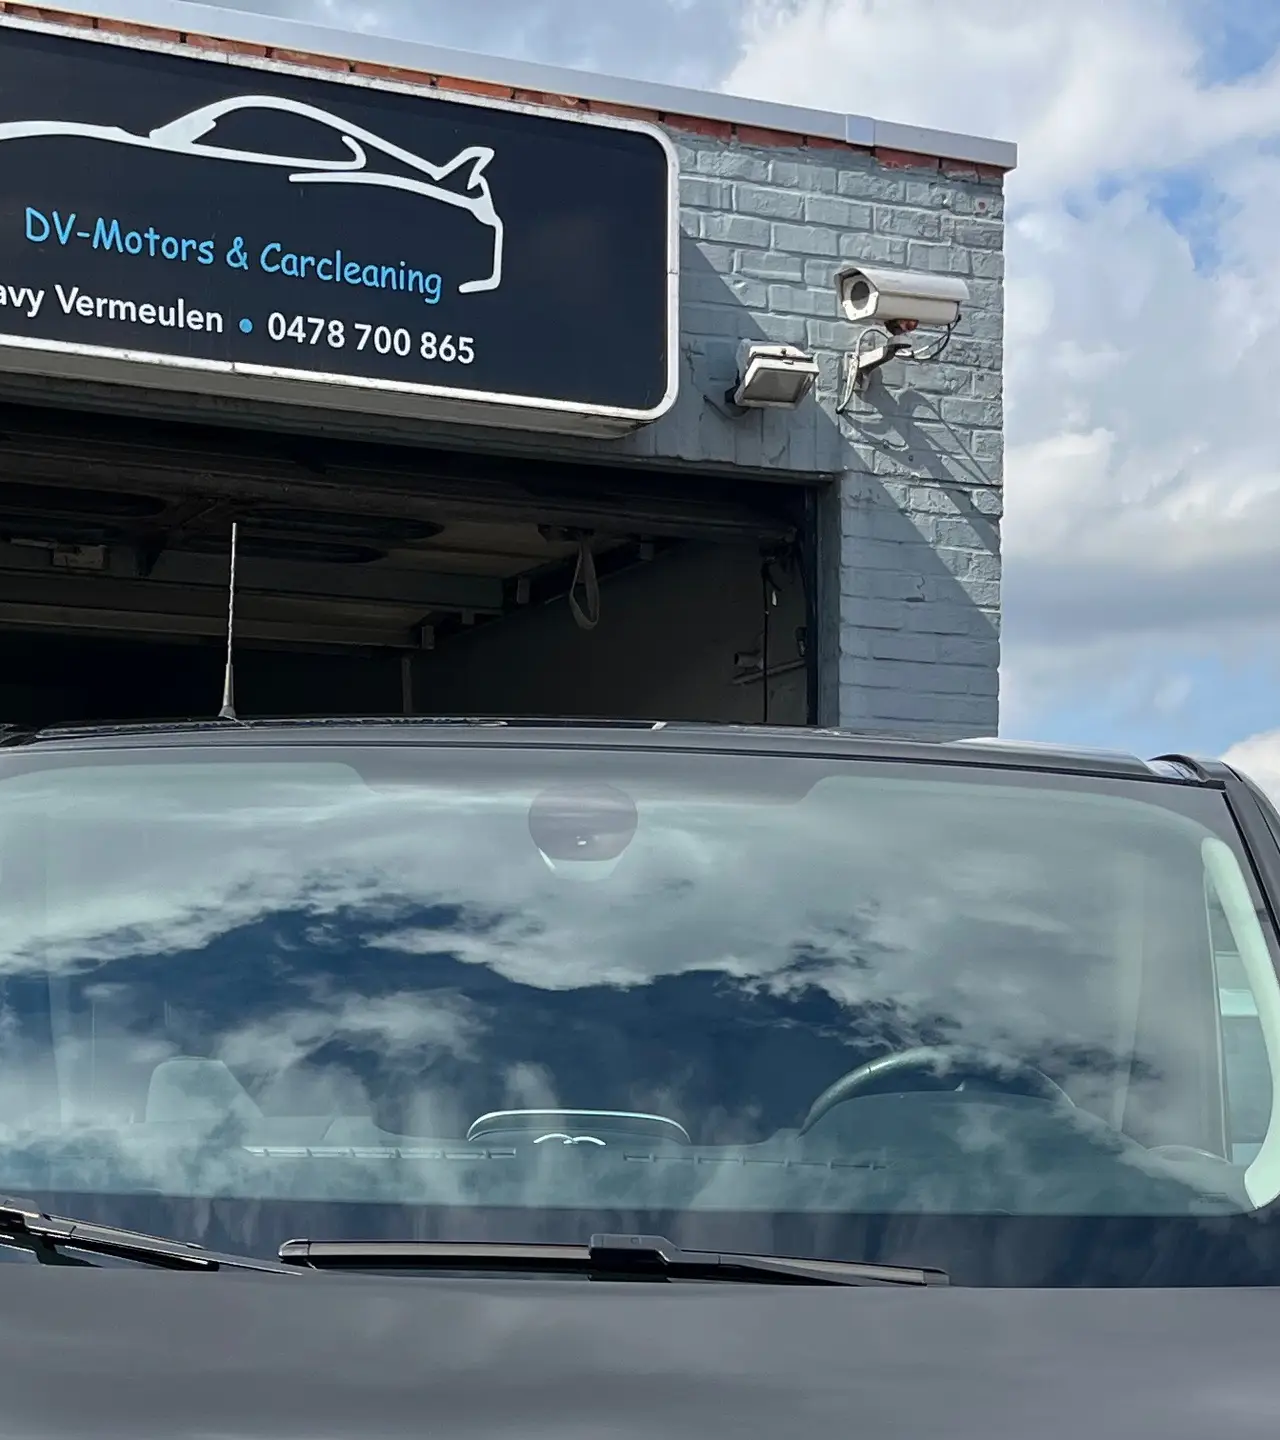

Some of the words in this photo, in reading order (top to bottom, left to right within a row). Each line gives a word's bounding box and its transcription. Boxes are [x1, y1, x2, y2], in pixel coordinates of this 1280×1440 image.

[25, 206, 214, 265] DV-Motors
[226, 236, 249, 270] &
[260, 242, 442, 304] Carcleaning
[54, 284, 223, 333] Vermeulen
[268, 312, 345, 348] 0478
[354, 323, 411, 356] 700
[420, 332, 475, 364] 865
